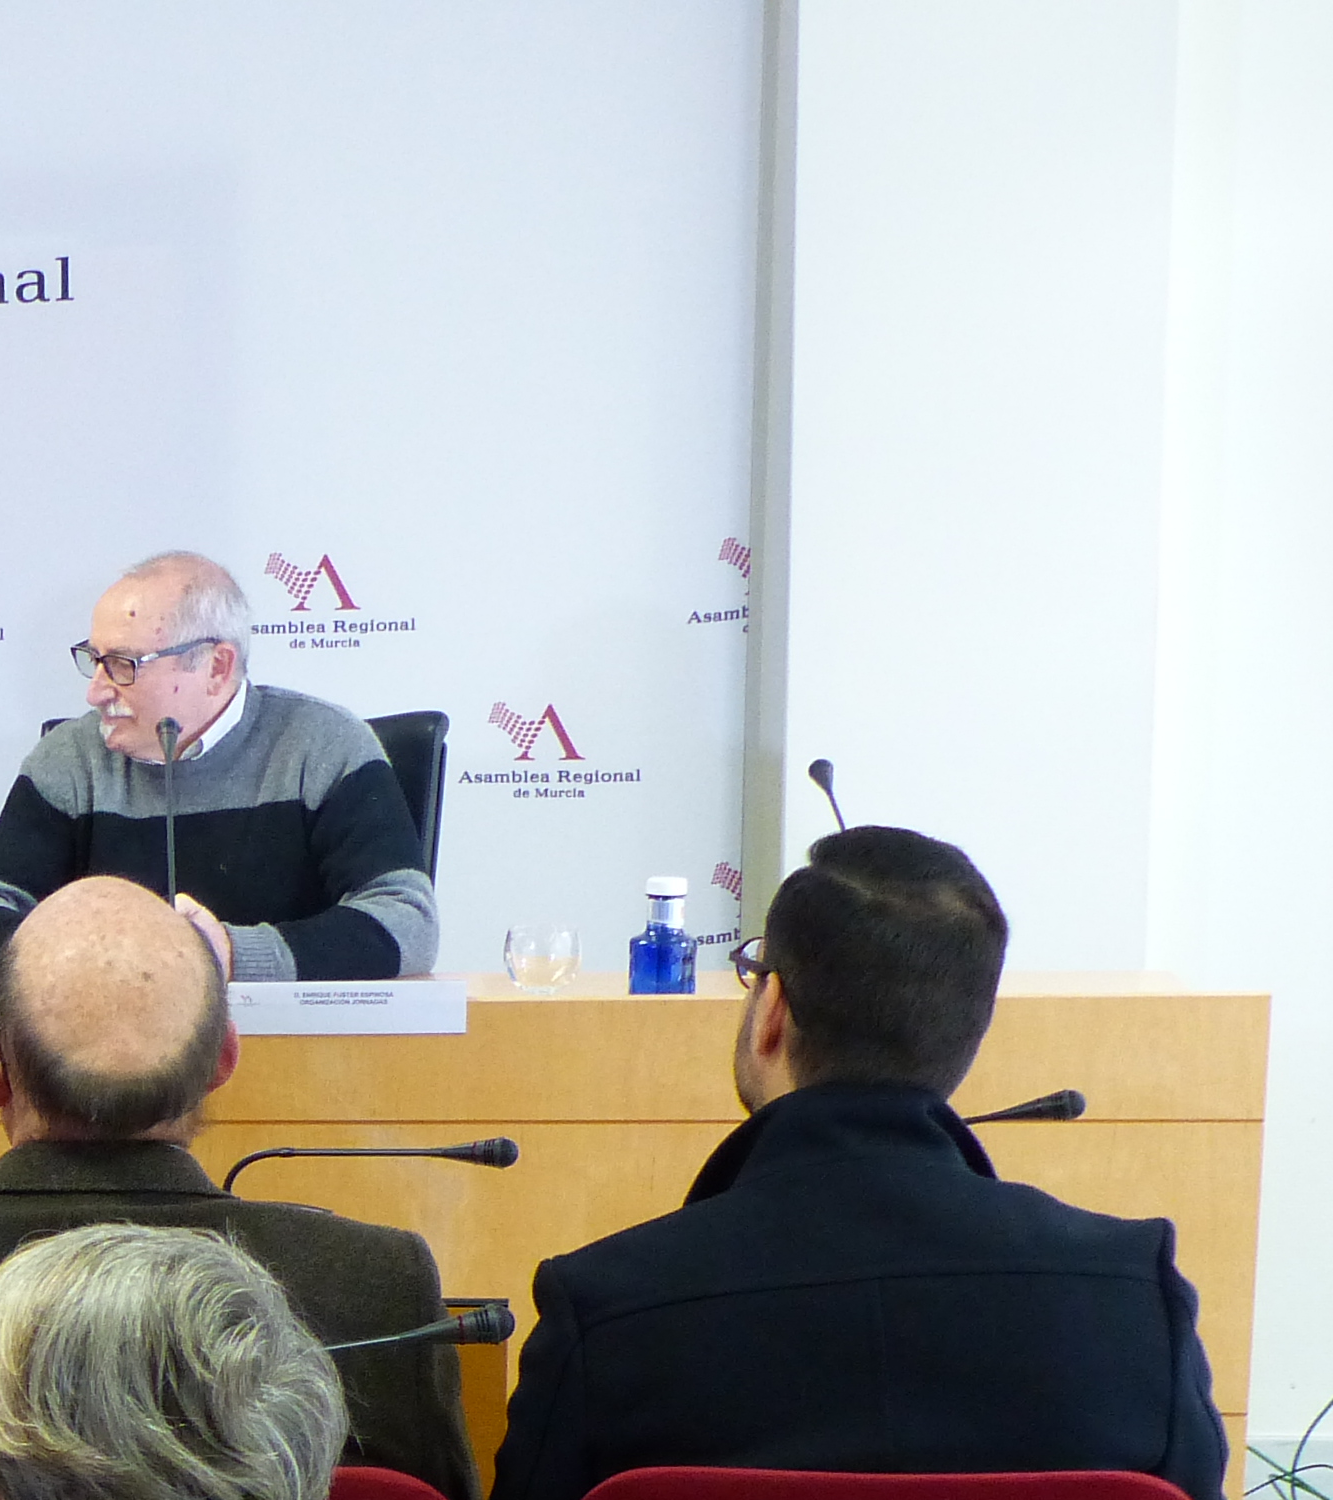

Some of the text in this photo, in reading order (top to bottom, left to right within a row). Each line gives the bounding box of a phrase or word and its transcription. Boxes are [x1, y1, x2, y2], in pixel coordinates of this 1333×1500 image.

[251, 617, 416, 635] samblea Regional
[289, 637, 361, 649] de Murcia
[458, 769, 641, 785] Asamblea Regional
[513, 787, 586, 799] de Murcia
